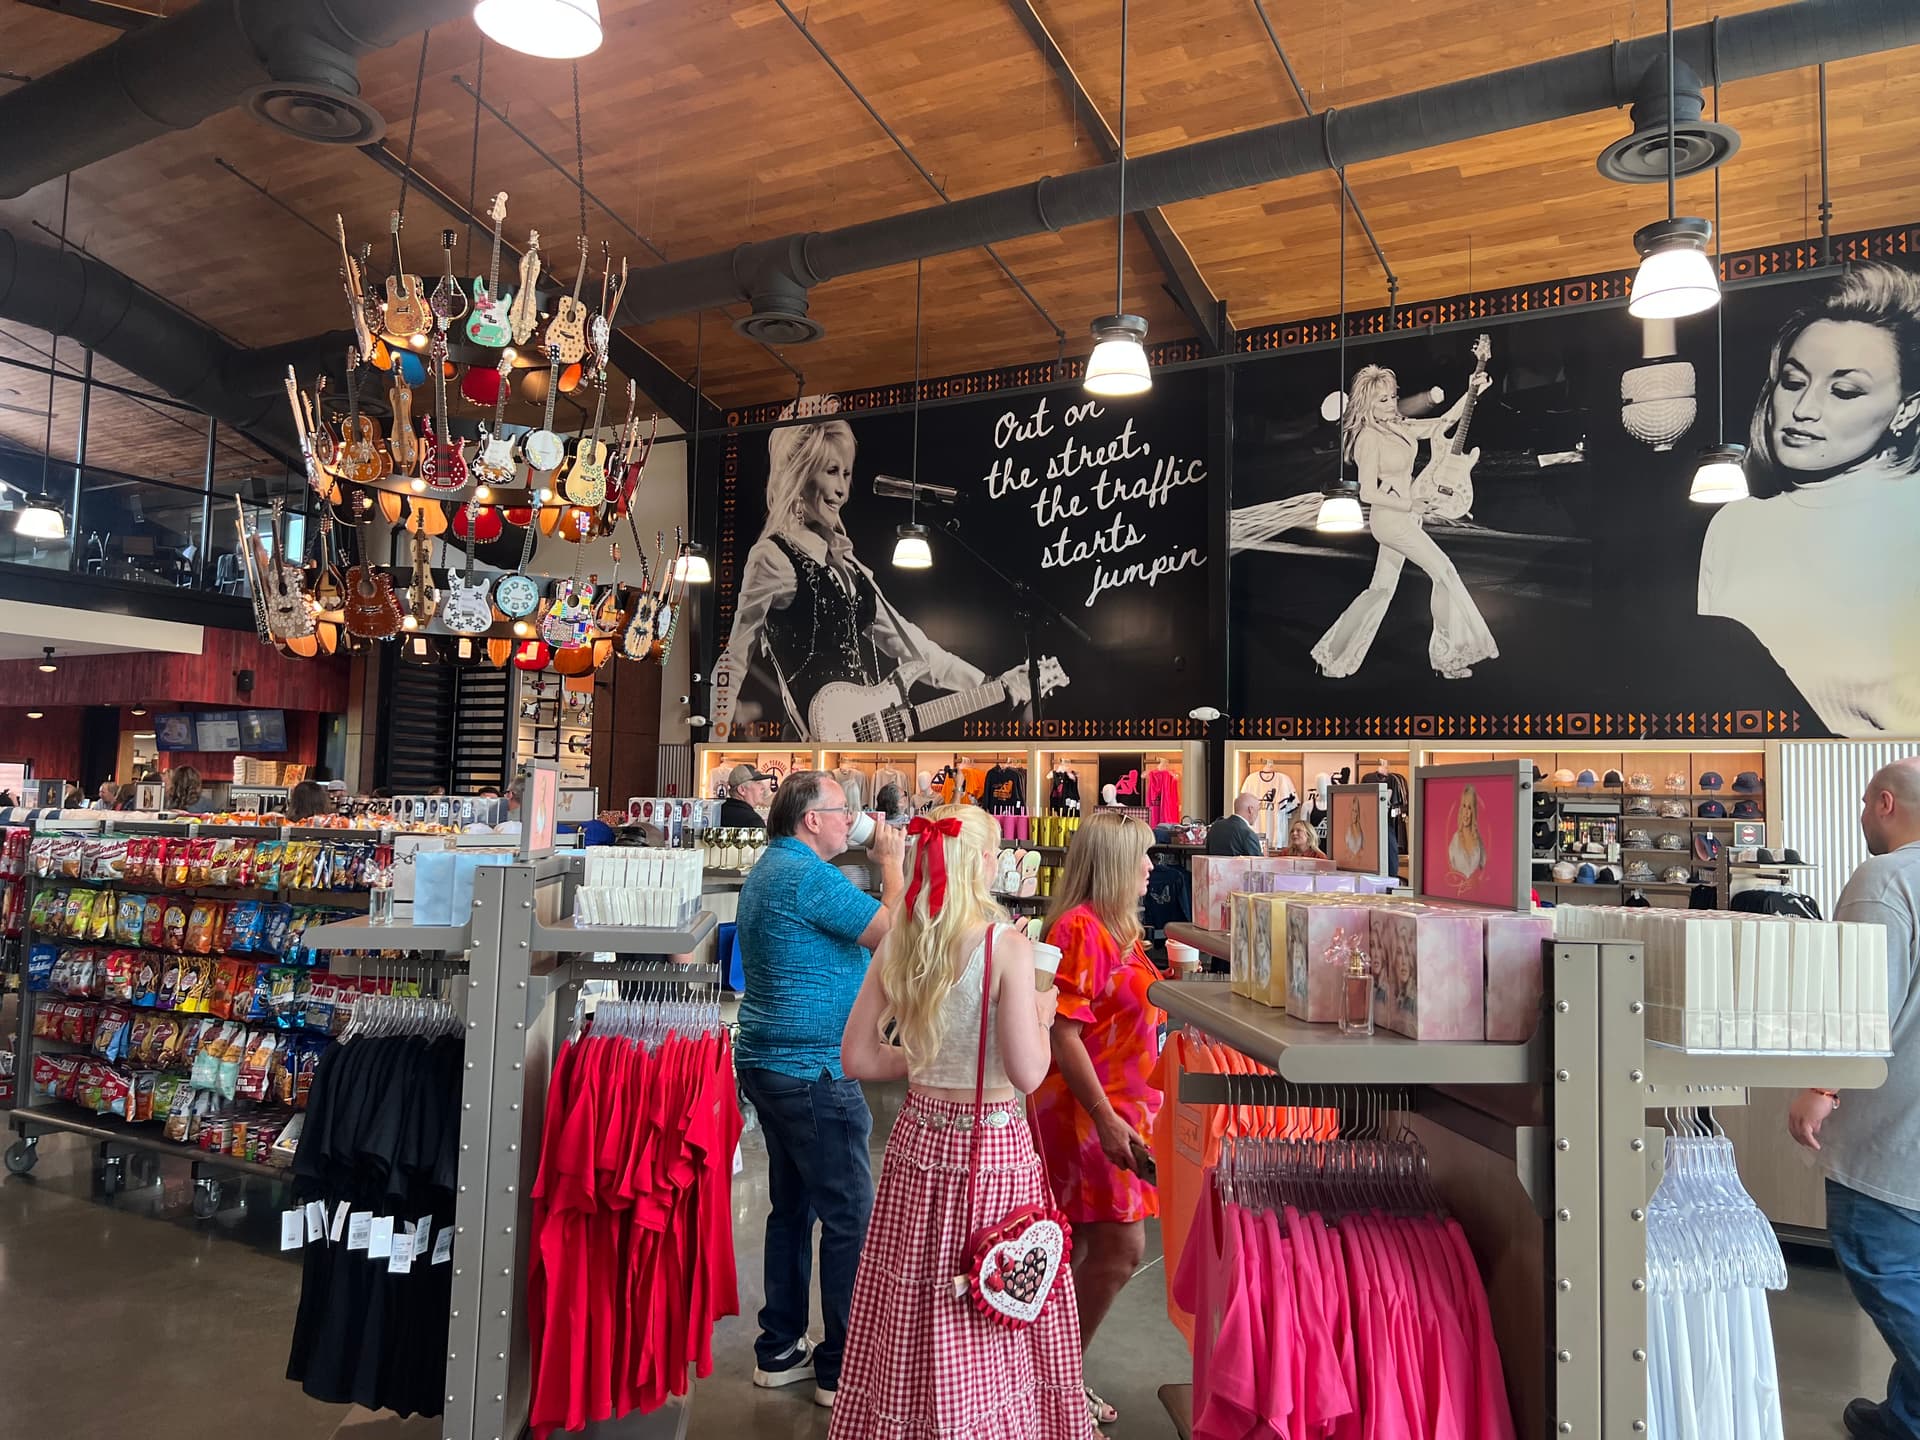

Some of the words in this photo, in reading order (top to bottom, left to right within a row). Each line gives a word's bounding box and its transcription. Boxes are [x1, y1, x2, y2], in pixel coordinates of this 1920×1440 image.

[994, 397, 1054, 448] Out
[1065, 401, 1105, 427] on
[983, 457, 1038, 499] the
[1046, 418, 1150, 480] street,
[1031, 485, 1088, 527] the
[1091, 455, 1207, 509] traffic
[1041, 512, 1146, 568] starts
[1085, 545, 1207, 607] jumpin
